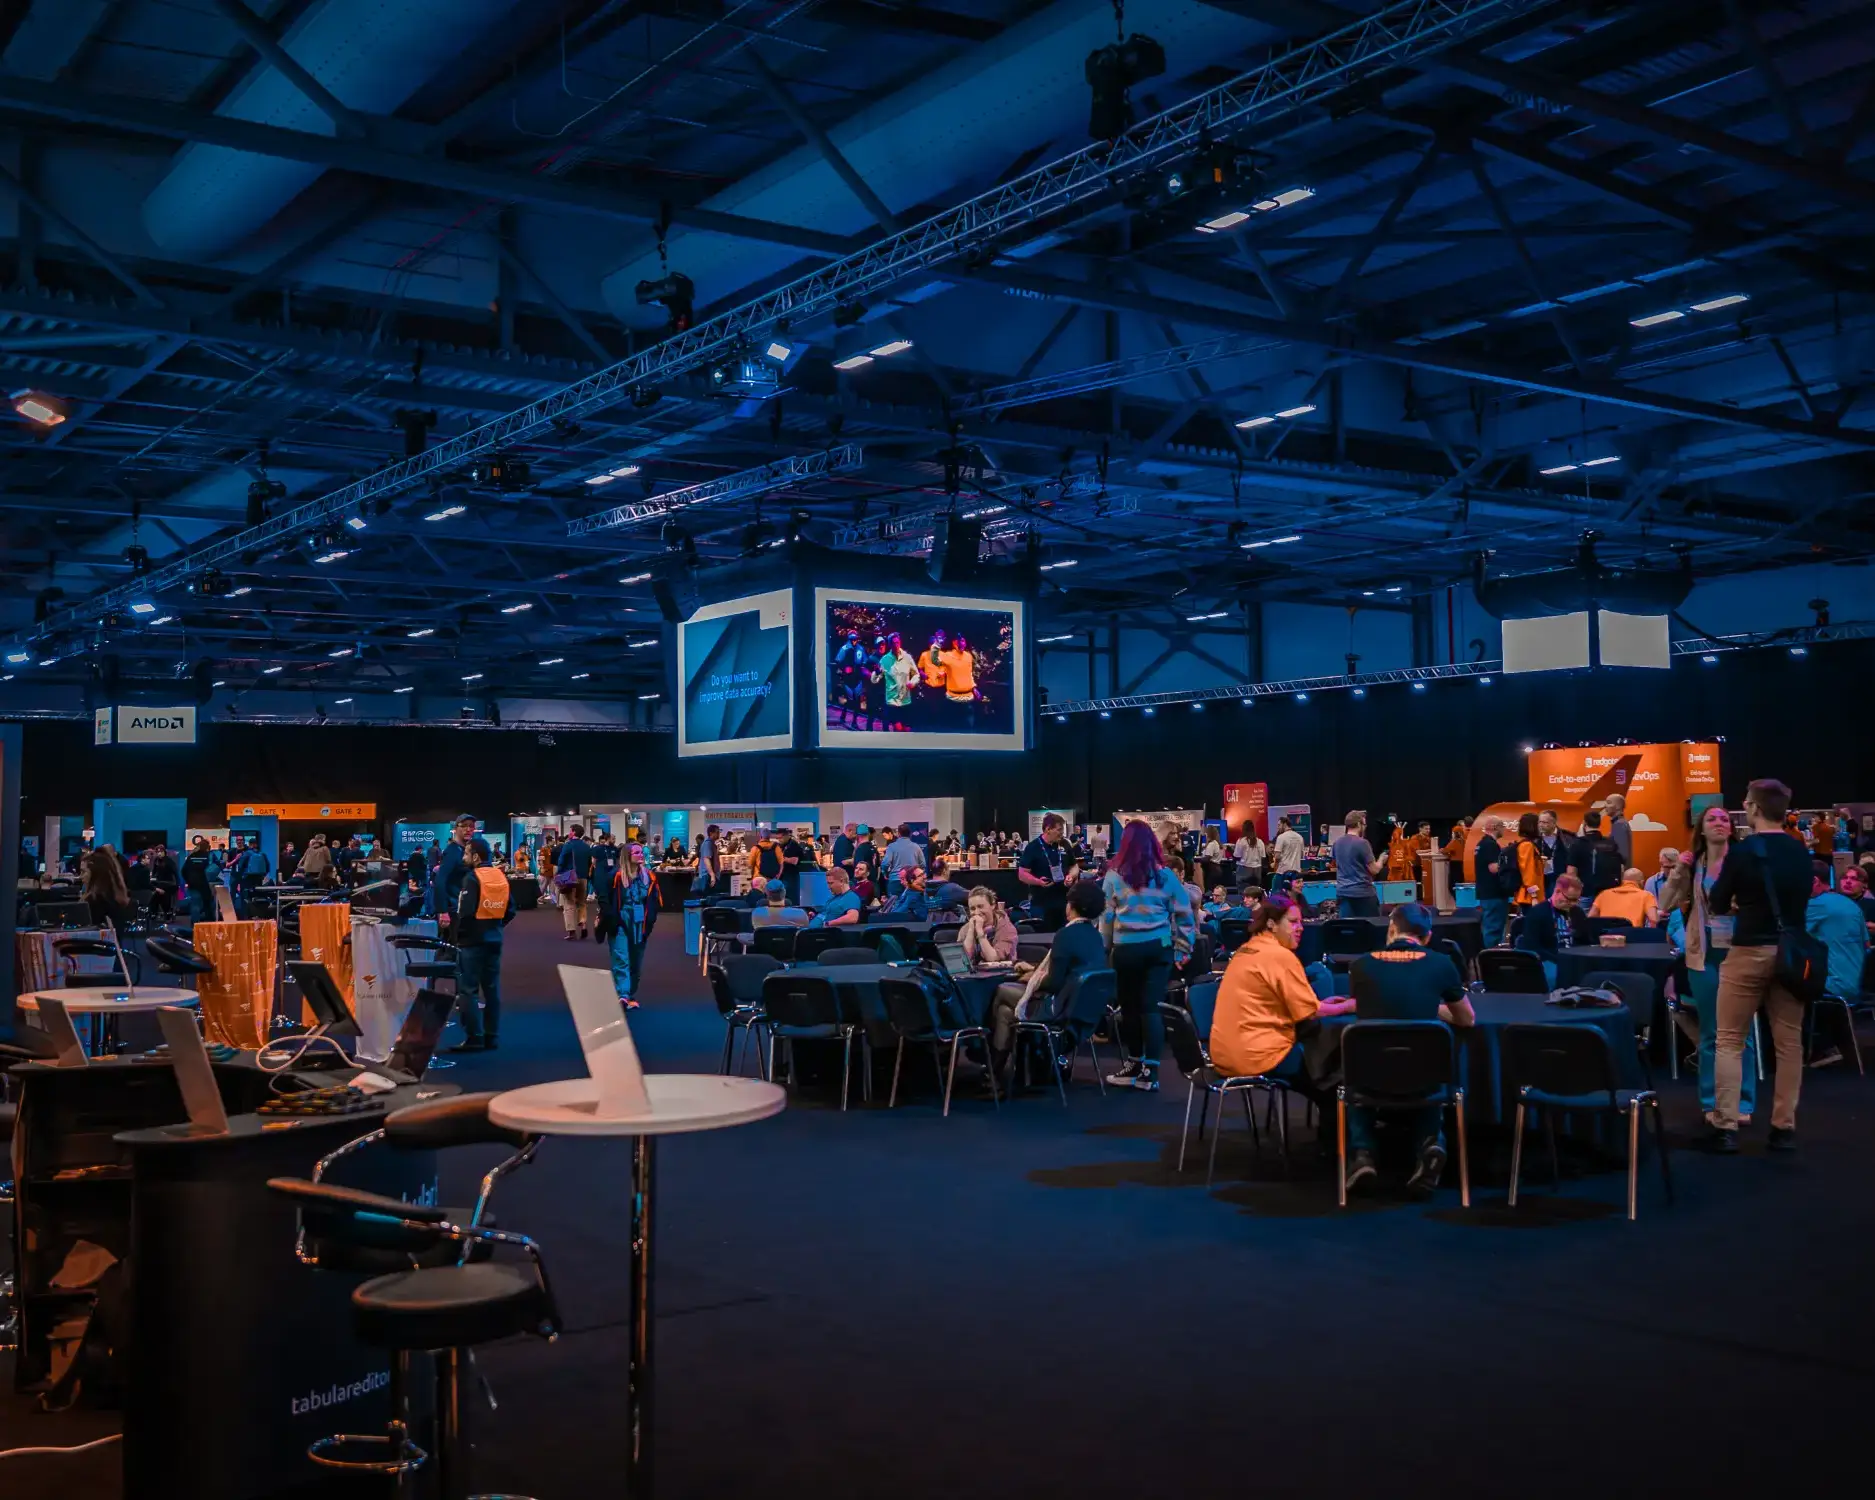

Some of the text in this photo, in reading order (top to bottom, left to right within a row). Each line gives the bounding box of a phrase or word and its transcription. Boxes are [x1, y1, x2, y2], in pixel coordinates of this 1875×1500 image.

[711, 671, 759, 687] Do you want to
[699, 681, 772, 704] improve data accuracy?
[131, 717, 169, 729] AMD
[1548, 774, 1591, 784] End-to-end
[1226, 789, 1240, 803] CAT
[259, 808, 277, 816] GATE
[482, 899, 505, 909] Quest
